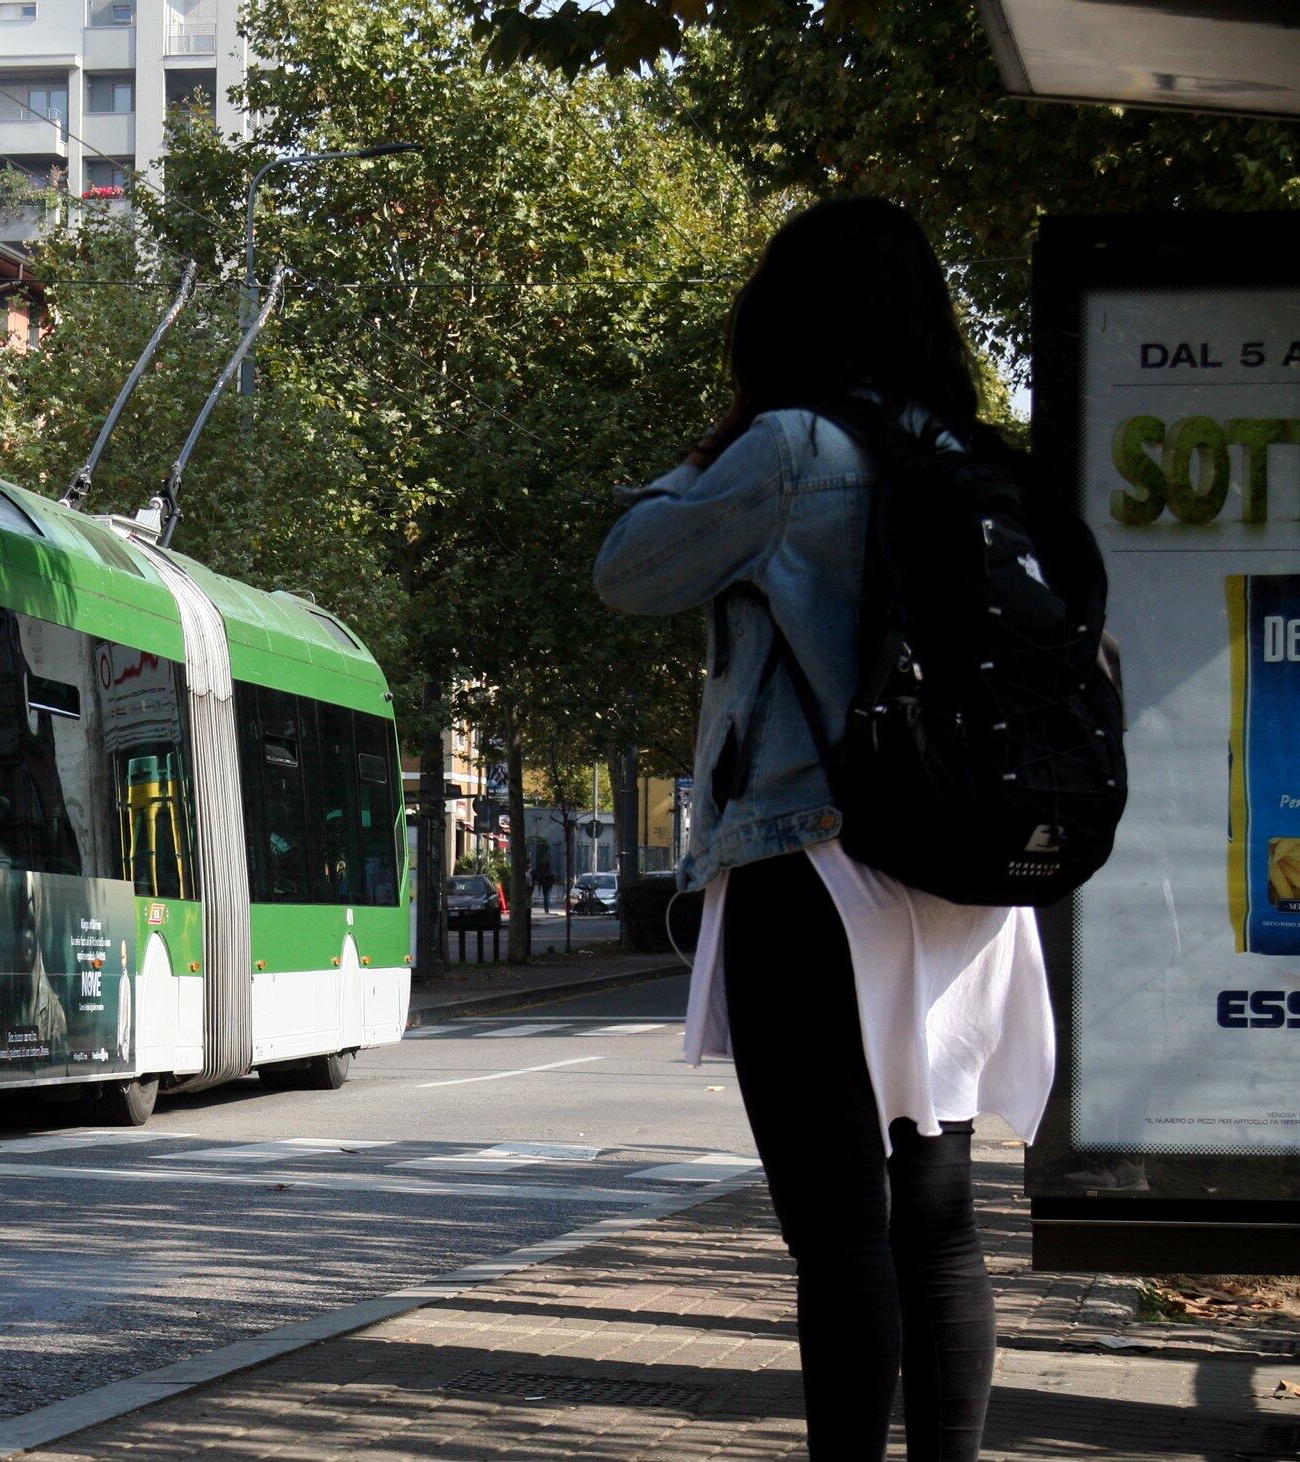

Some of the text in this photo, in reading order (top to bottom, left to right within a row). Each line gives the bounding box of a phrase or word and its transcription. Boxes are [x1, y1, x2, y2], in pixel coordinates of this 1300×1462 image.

[1140, 343, 1223, 369] DAL
[1240, 342, 1265, 368] 5
[1155, 1117, 1186, 1125] NUMERO
[1218, 1118, 1232, 1126] PER
